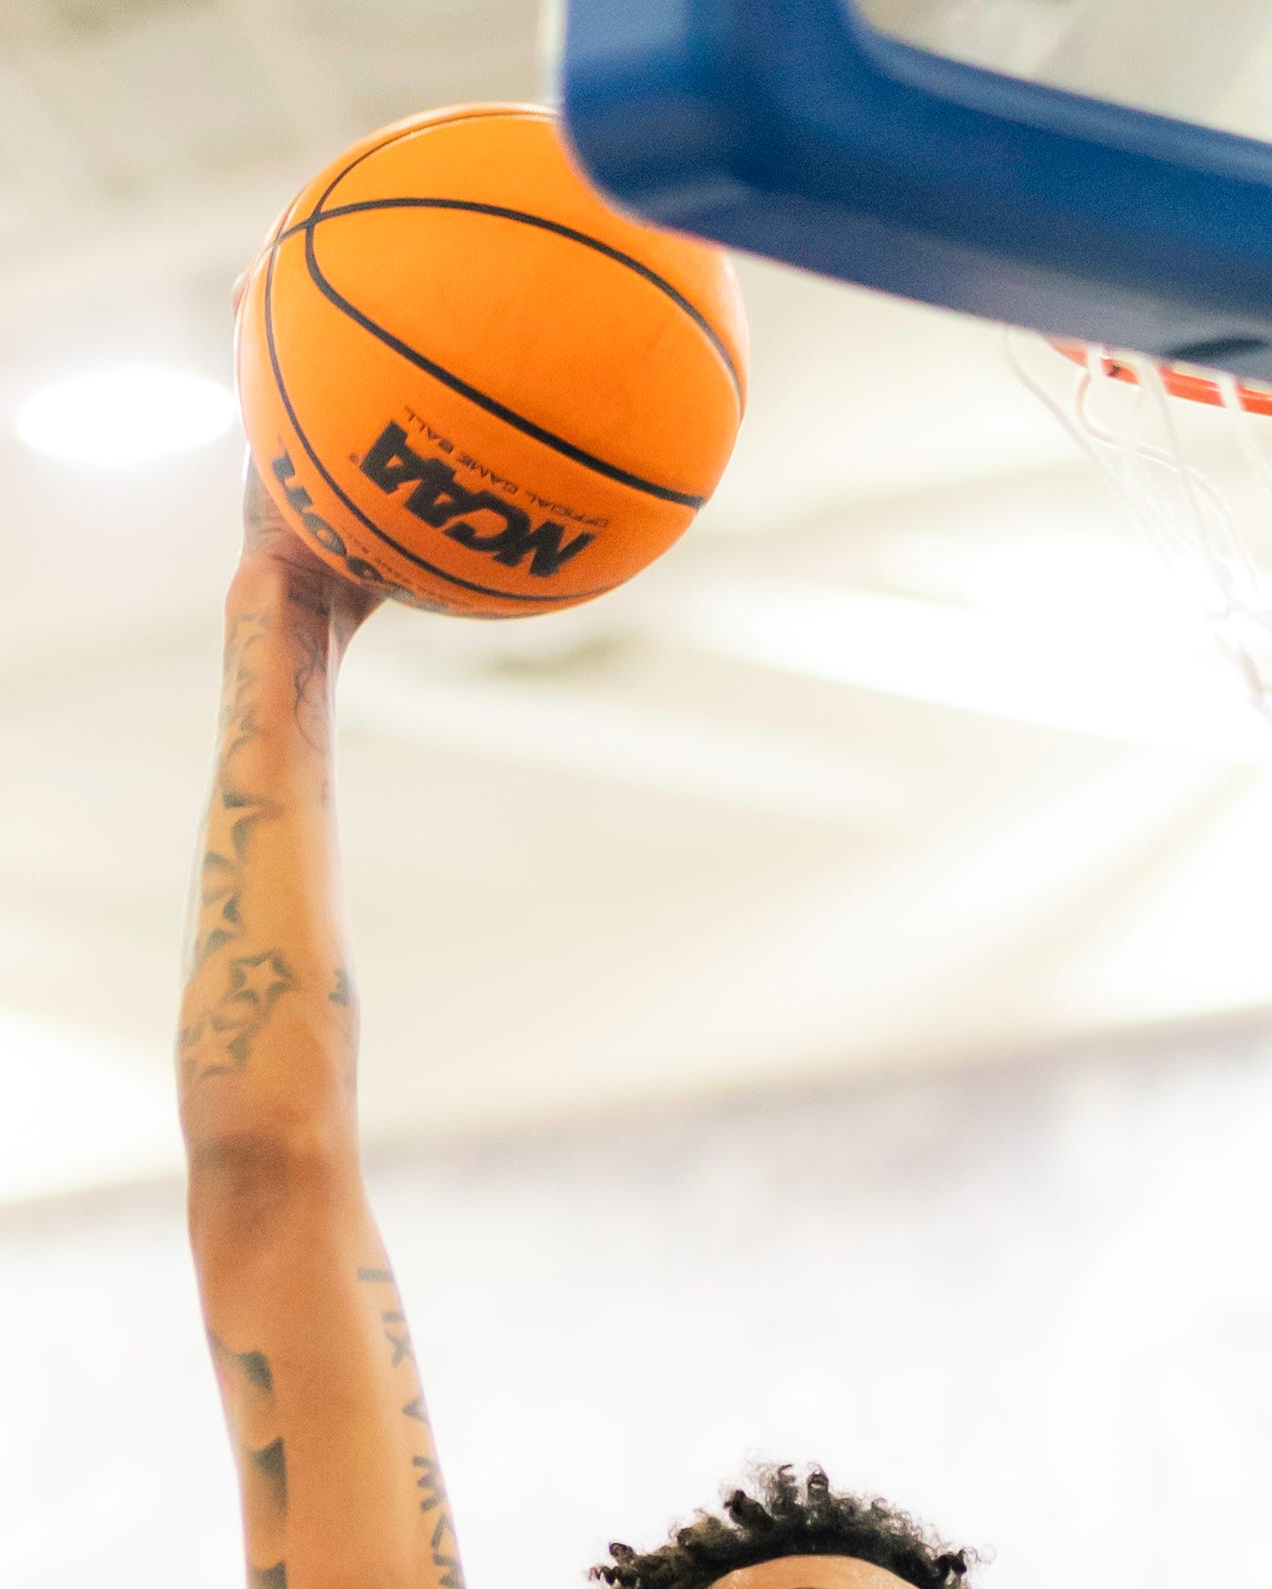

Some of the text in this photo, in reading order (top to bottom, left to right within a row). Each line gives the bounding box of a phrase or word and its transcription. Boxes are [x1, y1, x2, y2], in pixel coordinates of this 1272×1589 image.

[359, 420, 597, 578] NCAA
[403, 405, 610, 529] OFFICIAL GAME BALL
